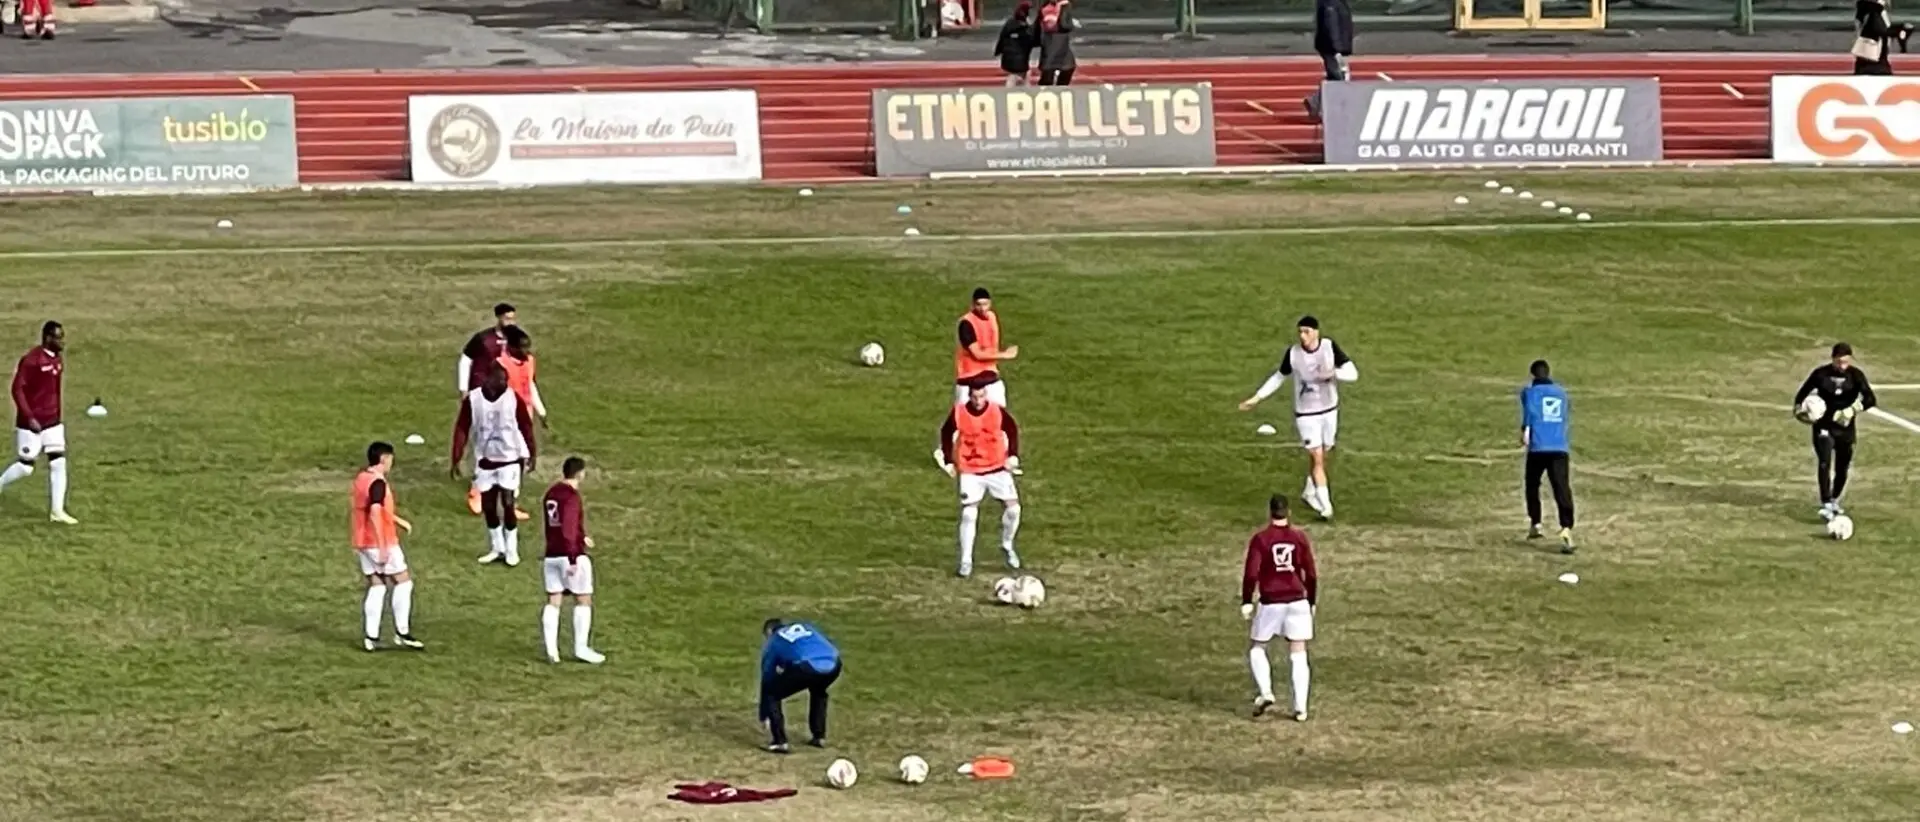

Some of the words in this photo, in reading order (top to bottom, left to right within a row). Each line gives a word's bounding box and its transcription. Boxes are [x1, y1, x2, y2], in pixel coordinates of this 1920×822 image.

[24, 109, 99, 134] NIVA
[887, 93, 997, 140] ETNA
[1006, 88, 1201, 139] PALLETS
[1359, 88, 1626, 141] MARGOIL
[511, 116, 543, 140] La
[551, 115, 640, 140] Maison
[645, 116, 675, 138] du
[683, 114, 737, 137] Pain
[26, 132, 106, 159] PACK
[1358, 144, 1401, 158] GAS
[1408, 144, 1465, 158] AUTO
[1472, 144, 1485, 158] E
[1493, 143, 1628, 158] CARBURANTI
[986, 153, 1108, 168] www.etnapallets.it
[15, 165, 127, 184] PACKAGING
[129, 164, 168, 182] DEL
[172, 163, 249, 181] FUTURO
